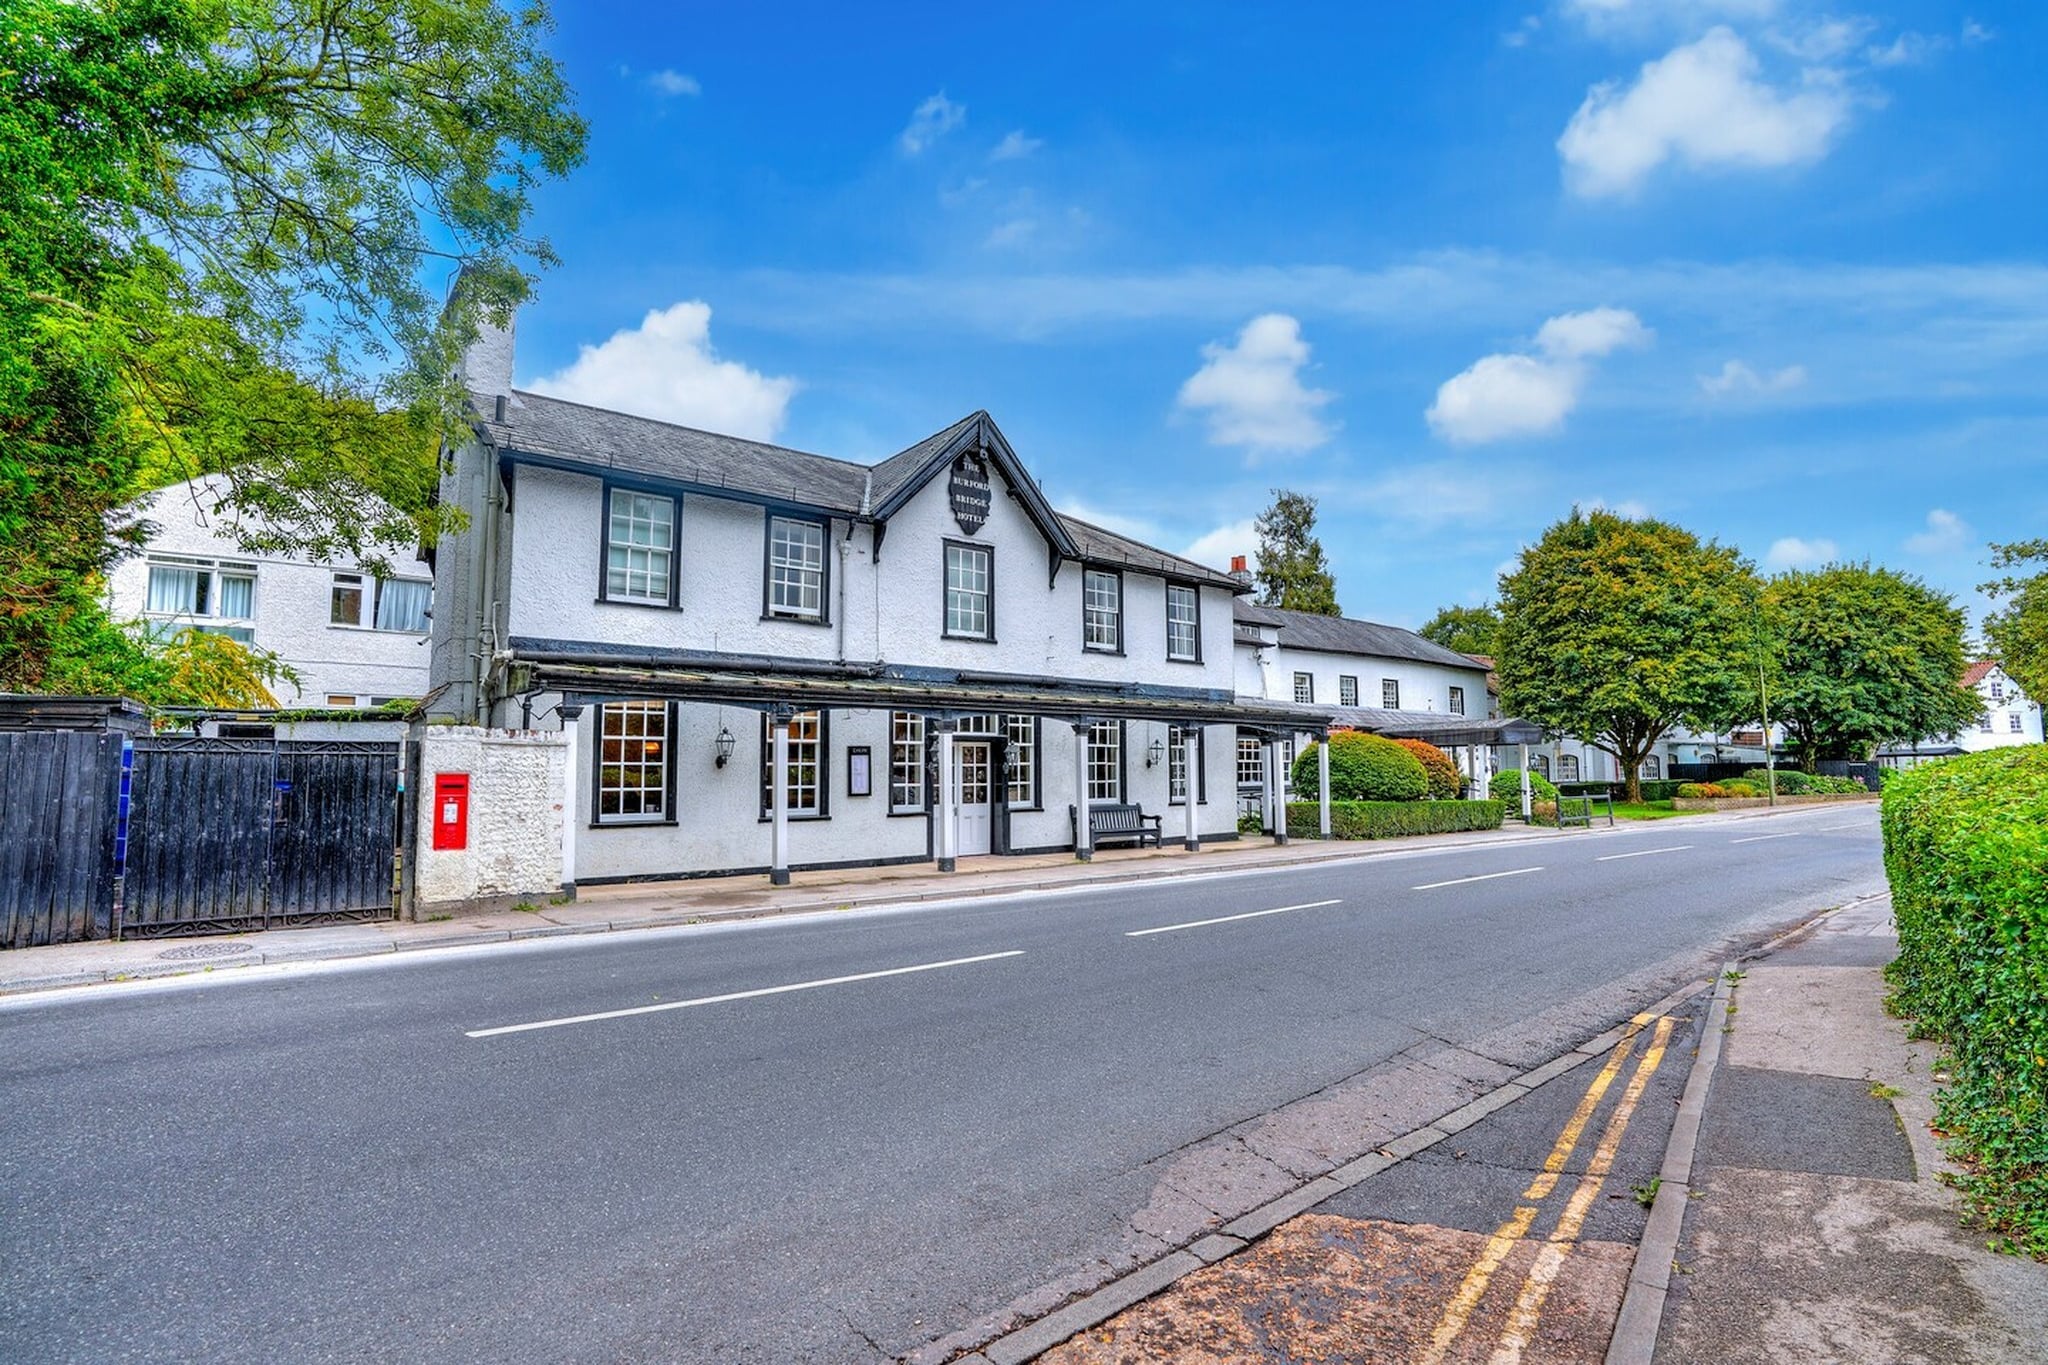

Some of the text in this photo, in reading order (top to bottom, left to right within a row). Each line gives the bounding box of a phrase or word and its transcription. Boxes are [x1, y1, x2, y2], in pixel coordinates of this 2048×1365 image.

[953, 476, 990, 491] BURFORD
[955, 494, 987, 507] BRIDGE
[957, 511, 985, 524] HOTEL
